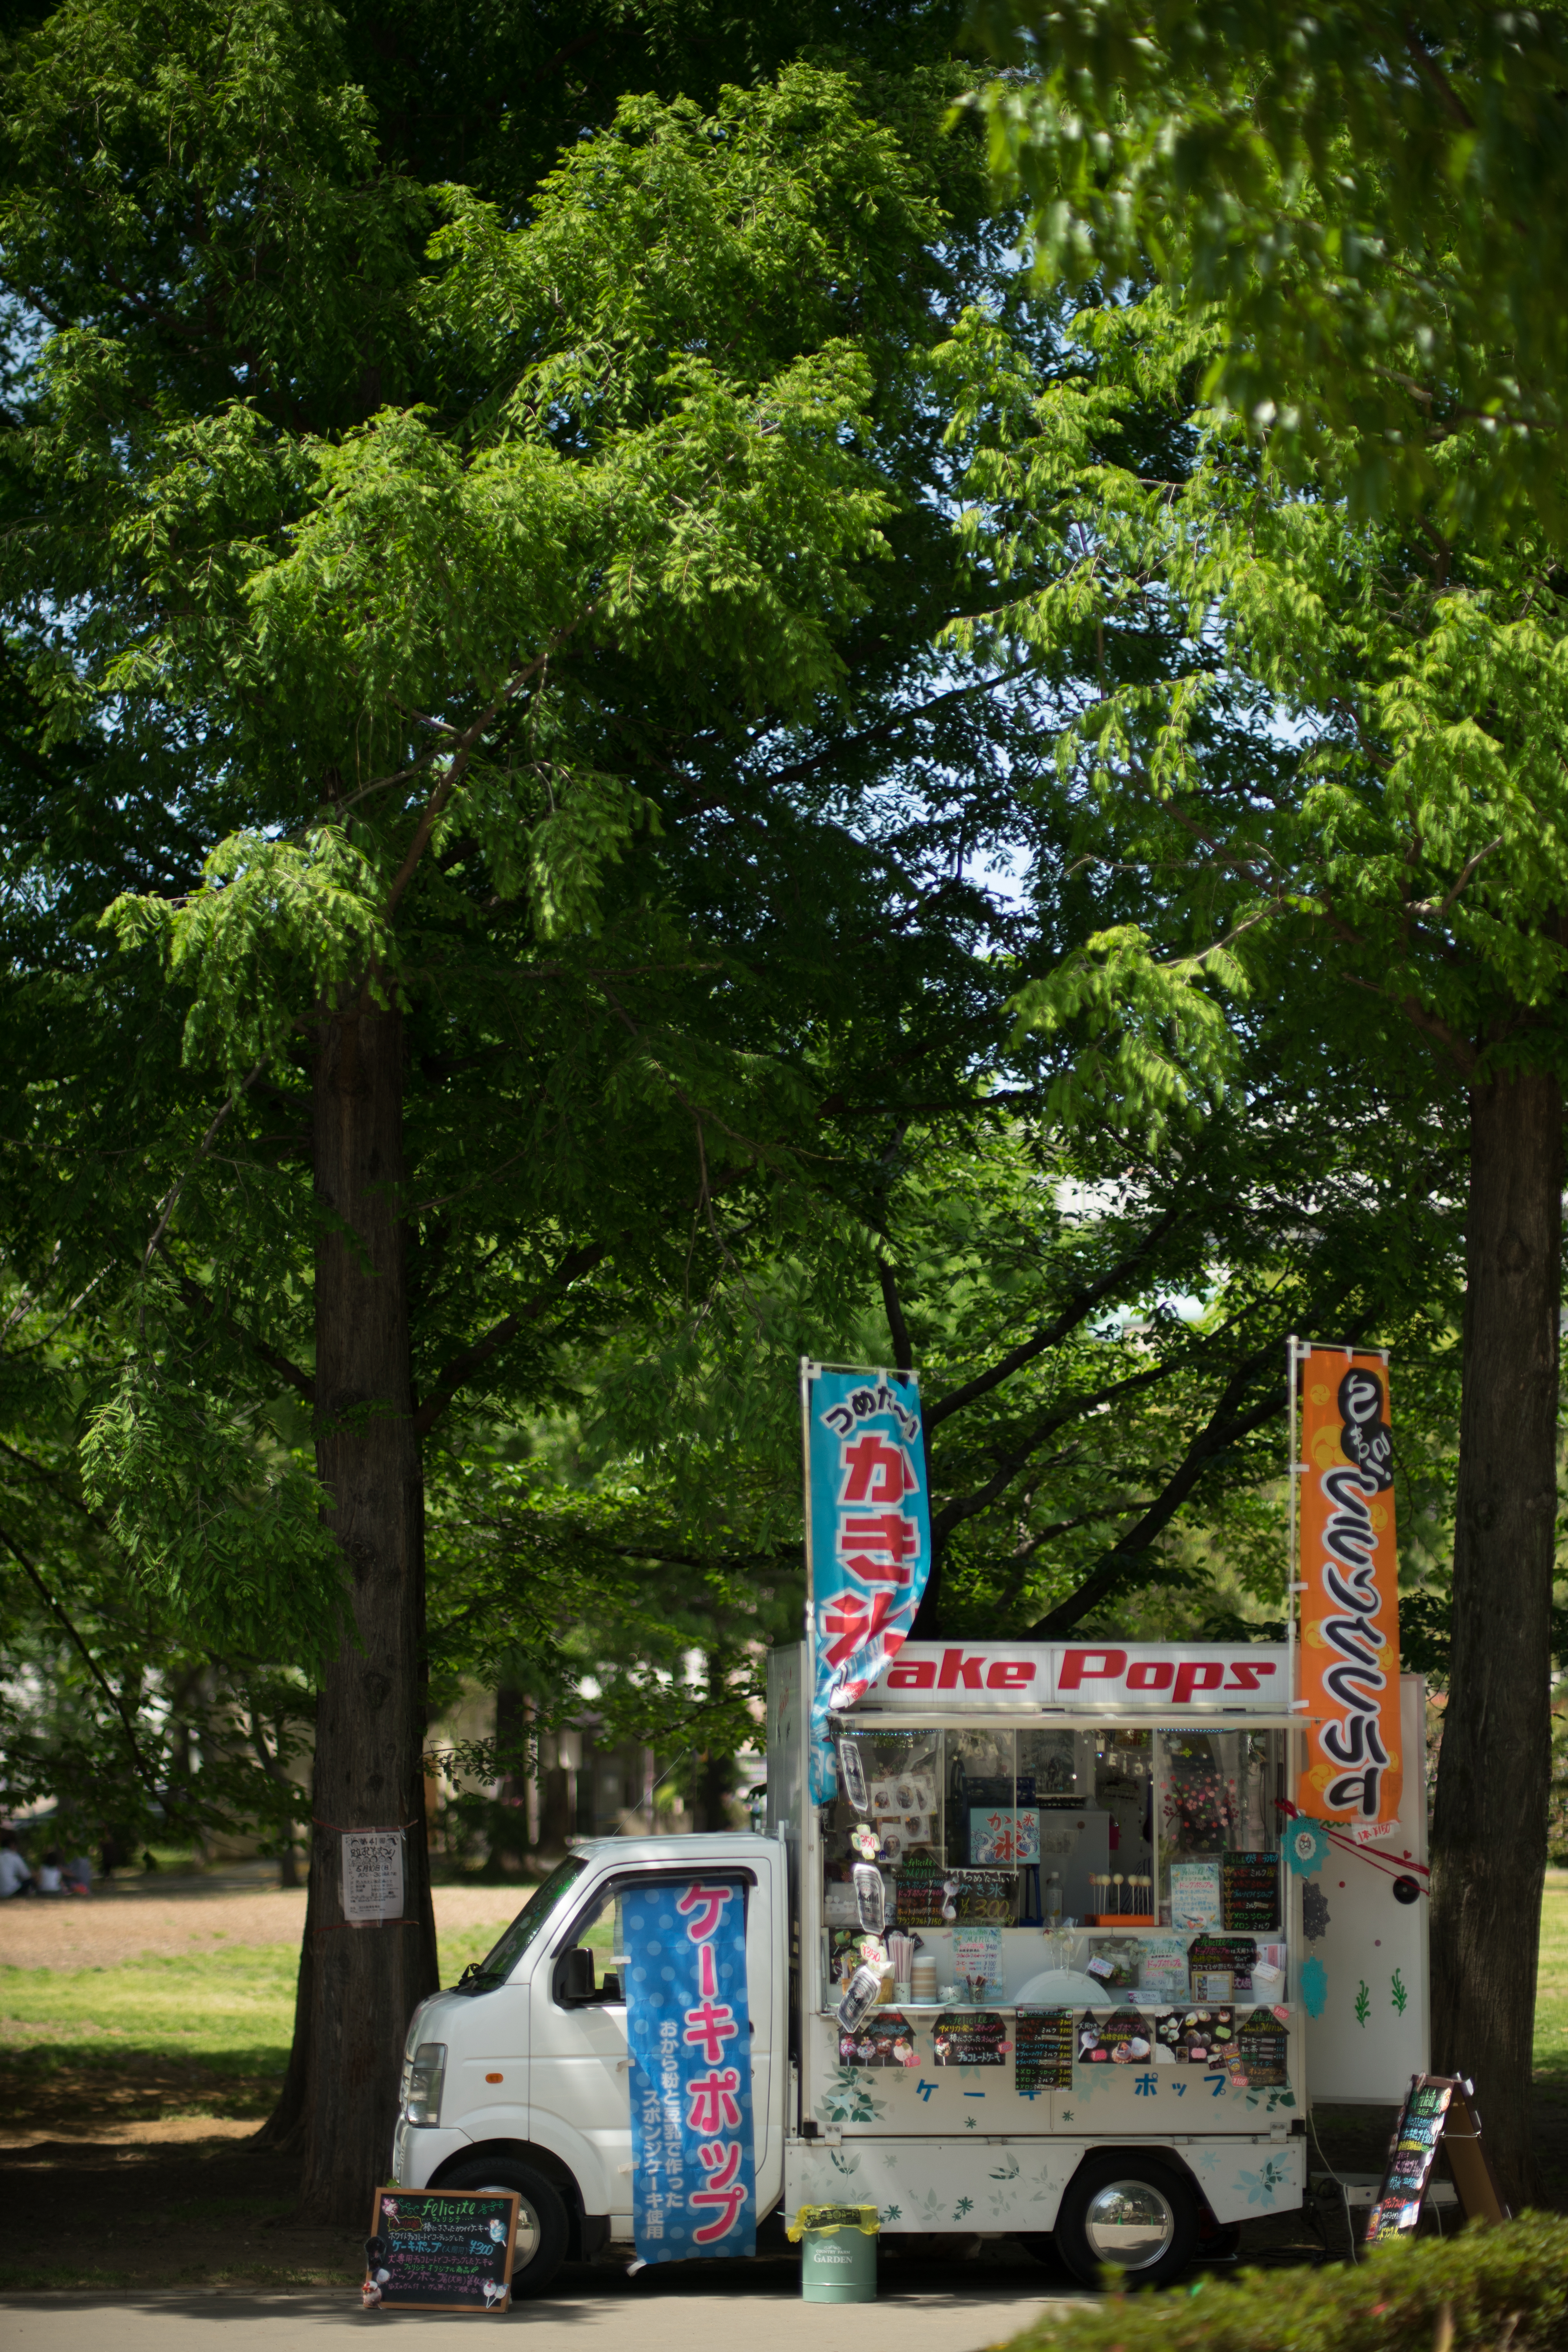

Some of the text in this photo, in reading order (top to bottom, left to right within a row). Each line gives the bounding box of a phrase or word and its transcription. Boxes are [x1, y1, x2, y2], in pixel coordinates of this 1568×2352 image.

[871, 1648, 1277, 1703] ake Pops
[1372, 1824, 1390, 1837] ¥150
[856, 1835, 875, 1848] ¥350
[908, 1858, 932, 1867] felicite
[897, 1881, 928, 1889] ケーキポップ
[959, 1883, 1005, 1897] かき氷
[898, 1889, 928, 1898] ドッグポップ
[960, 1897, 1009, 1918] ¥300
[897, 1917, 927, 1925] フランクフルト
[862, 1945, 881, 1962] ¥350
[1235, 1978, 1252, 1988] 大人気
[953, 2014, 988, 2025] felicite
[1275, 2007, 1289, 2019] ¥100
[869, 2023, 909, 2035] ケーキポップ
[939, 2024, 996, 2033] アメリカ発の スイーツ
[680, 1882, 744, 2242] ケーキポップ
[957, 2051, 1001, 2062] チョコレートケーキ
[1134, 2072, 1227, 2098] ポップ
[660, 2021, 684, 2208] おから粉と豆乳で作った
[1403, 2127, 1423, 2141] ケーキポップ
[643, 2091, 664, 2239] スポンジケーキ使用
[421, 2198, 475, 2216] felicite
[392, 2240, 442, 2253] ケーキポップ
[468, 2240, 495, 2256] ¥300
[814, 2254, 853, 2263] GARDEN
